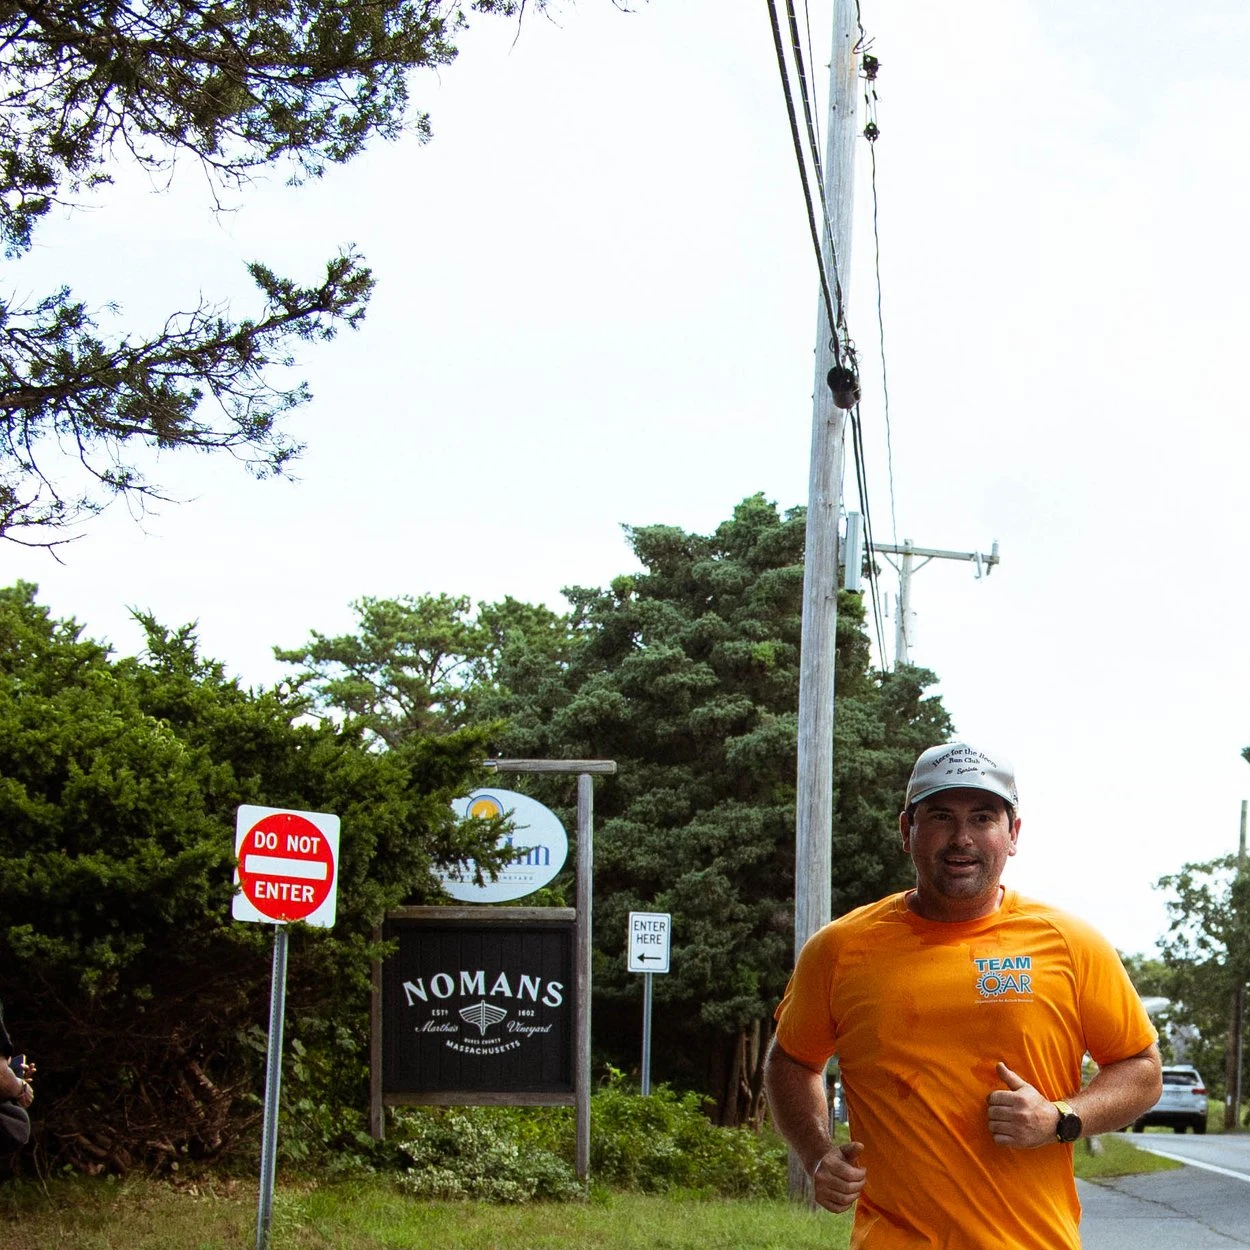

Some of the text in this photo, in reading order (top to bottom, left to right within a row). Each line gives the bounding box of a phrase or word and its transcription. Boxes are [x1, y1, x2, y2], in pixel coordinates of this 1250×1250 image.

[951, 748, 963, 757] for
[964, 748, 977, 756] the
[254, 831, 320, 854] DO NOT
[254, 880, 315, 903] ENTER
[634, 920, 666, 932] ENTER
[636, 933, 662, 945] HERE
[974, 956, 1032, 972] TEAM
[402, 970, 564, 1008] NOMANS
[976, 973, 1033, 997] OAR
[518, 1009, 535, 1017] 1602
[506, 1020, 553, 1038] Vineyard
[446, 1040, 521, 1055] MASSACHUSETTS
